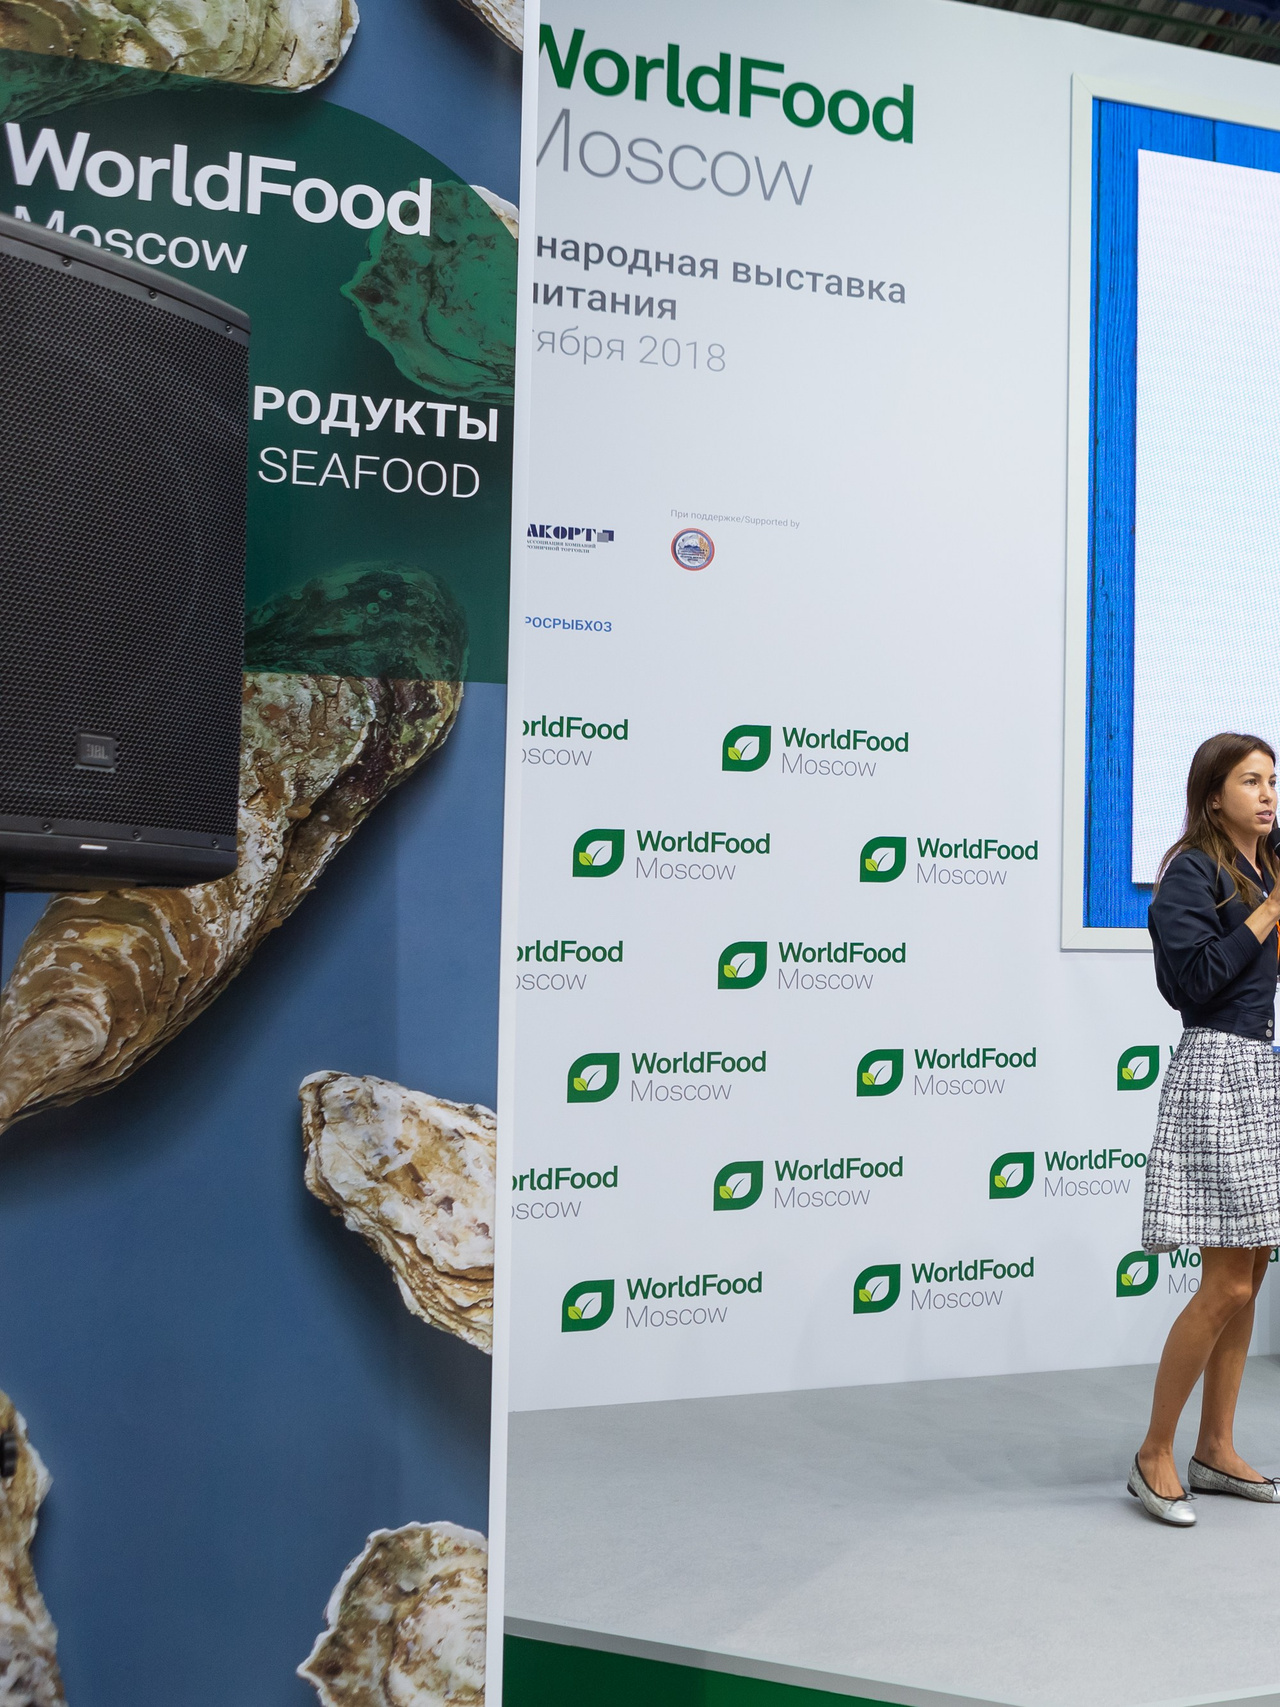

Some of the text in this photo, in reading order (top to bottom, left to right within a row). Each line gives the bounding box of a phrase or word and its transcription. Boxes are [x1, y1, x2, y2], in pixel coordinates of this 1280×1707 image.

[5, 122, 432, 237] WorldFood
[537, 235, 906, 304] народная выставка
[532, 325, 725, 372] ября 2018
[253, 386, 497, 442] РОДУКТЫ
[258, 447, 480, 498] SEAFOOD
[670, 509, 689, 519] При
[790, 519, 800, 529] by
[527, 523, 596, 541] АКОРТ
[522, 715, 627, 740] rldFood
[782, 727, 909, 752] WorldFood
[87, 743, 108, 760] JBL
[521, 748, 592, 766] scow
[782, 753, 876, 777] Moscow
[636, 830, 770, 854] WorldFood
[917, 838, 1038, 860] WorldFood
[635, 858, 735, 881] Moscow
[916, 864, 1007, 885] Moscow
[517, 940, 623, 962] rldFood
[779, 943, 906, 963] WorldFood
[516, 974, 587, 990] scow
[778, 969, 874, 990] Moscow
[632, 1052, 767, 1075] WorldFood
[914, 1048, 1036, 1070] WorldFood
[630, 1080, 732, 1102] Moscow
[914, 1075, 1005, 1096] Moscow
[774, 1157, 903, 1181] WorldFood
[1045, 1149, 1147, 1173] WorldFoo
[512, 1165, 618, 1191] rldFood
[1044, 1176, 1131, 1197] Moscow
[774, 1187, 870, 1208] Moscow
[512, 1201, 581, 1219] scow
[911, 1257, 1034, 1284] WorldFood
[626, 1272, 762, 1301] WorldFood
[910, 1288, 1002, 1311] Moscow
[625, 1306, 727, 1329] Moscow
